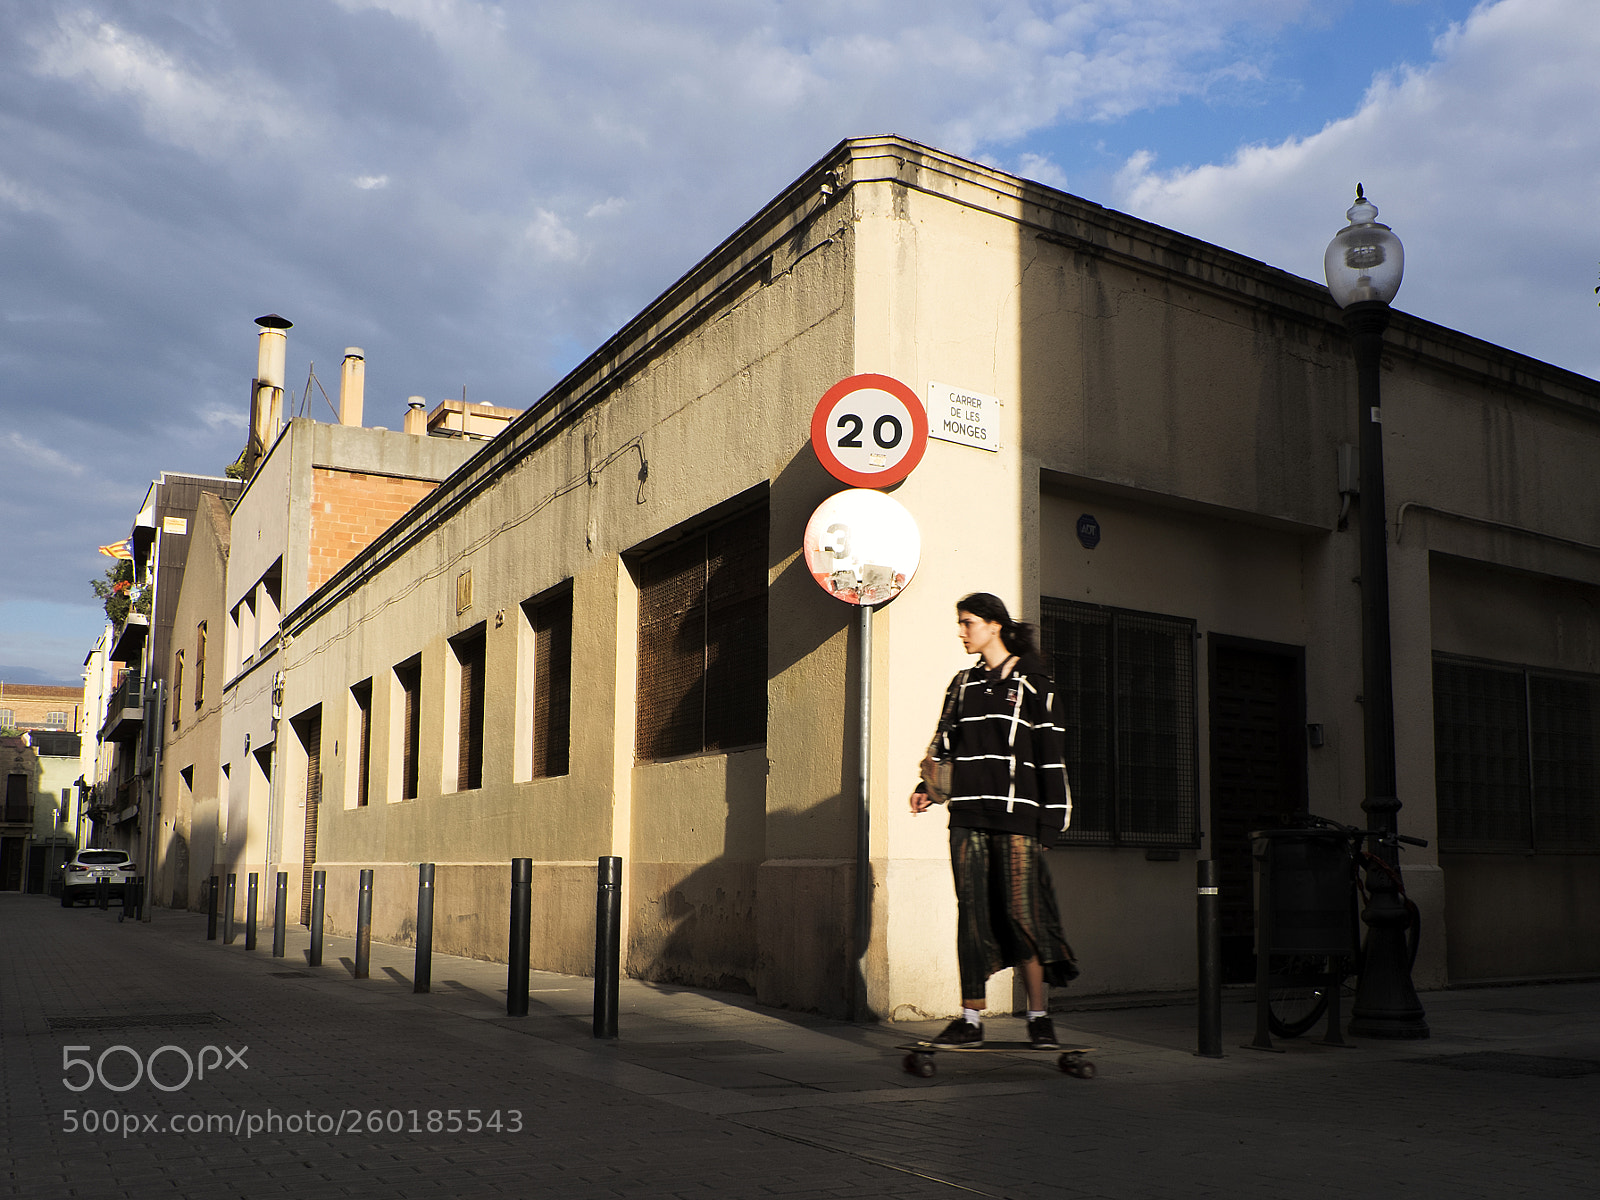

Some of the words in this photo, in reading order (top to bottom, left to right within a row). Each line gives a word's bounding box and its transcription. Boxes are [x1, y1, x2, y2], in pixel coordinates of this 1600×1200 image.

[949, 393, 981, 409] CARRER
[951, 407, 961, 418] DE
[965, 411, 980, 423] LES
[837, 413, 903, 449] 20
[943, 419, 987, 440] MONGES
